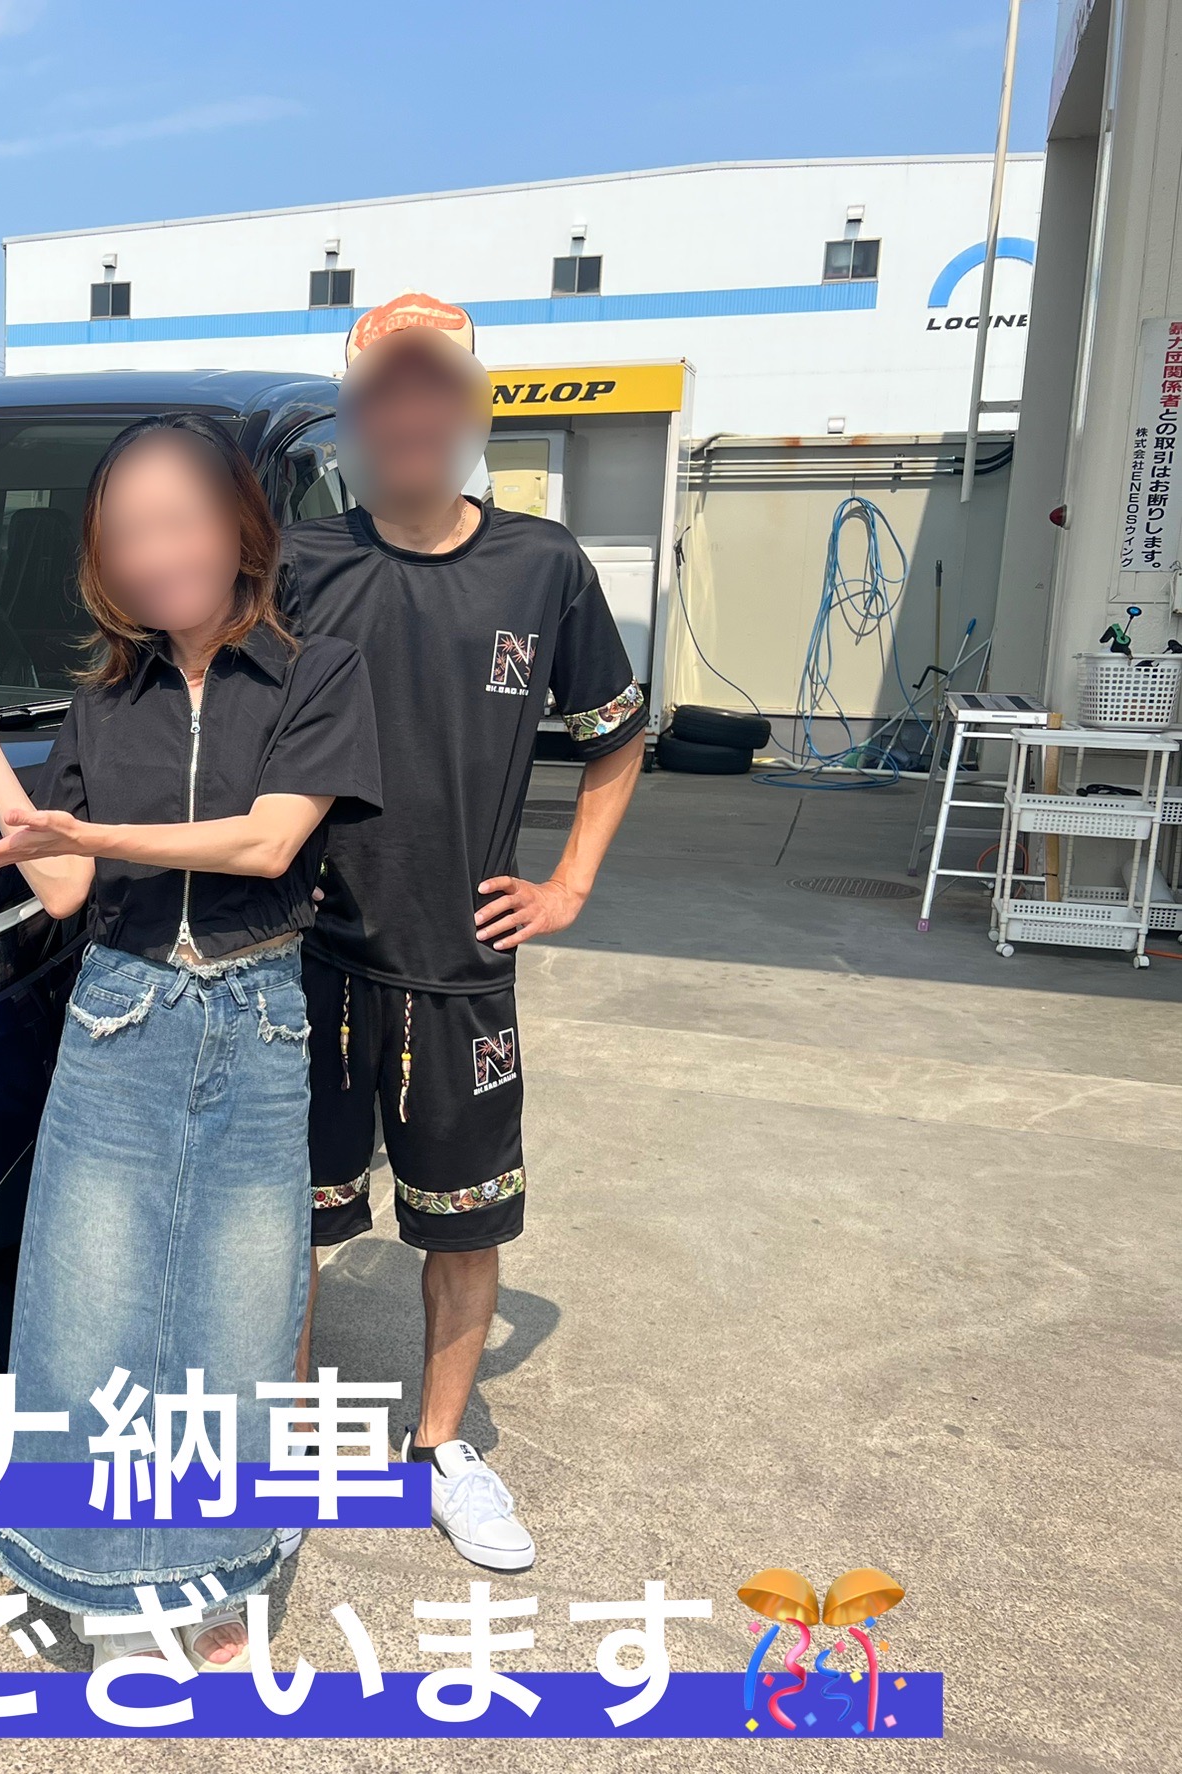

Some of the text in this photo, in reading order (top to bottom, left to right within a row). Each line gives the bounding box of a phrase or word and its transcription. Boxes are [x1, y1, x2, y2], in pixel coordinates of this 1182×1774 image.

[491, 380, 617, 405] NLOP
[1120, 427, 1149, 569] 株式会社ENEOSウイング
[490, 630, 539, 688] N
[472, 1027, 515, 1087] N
